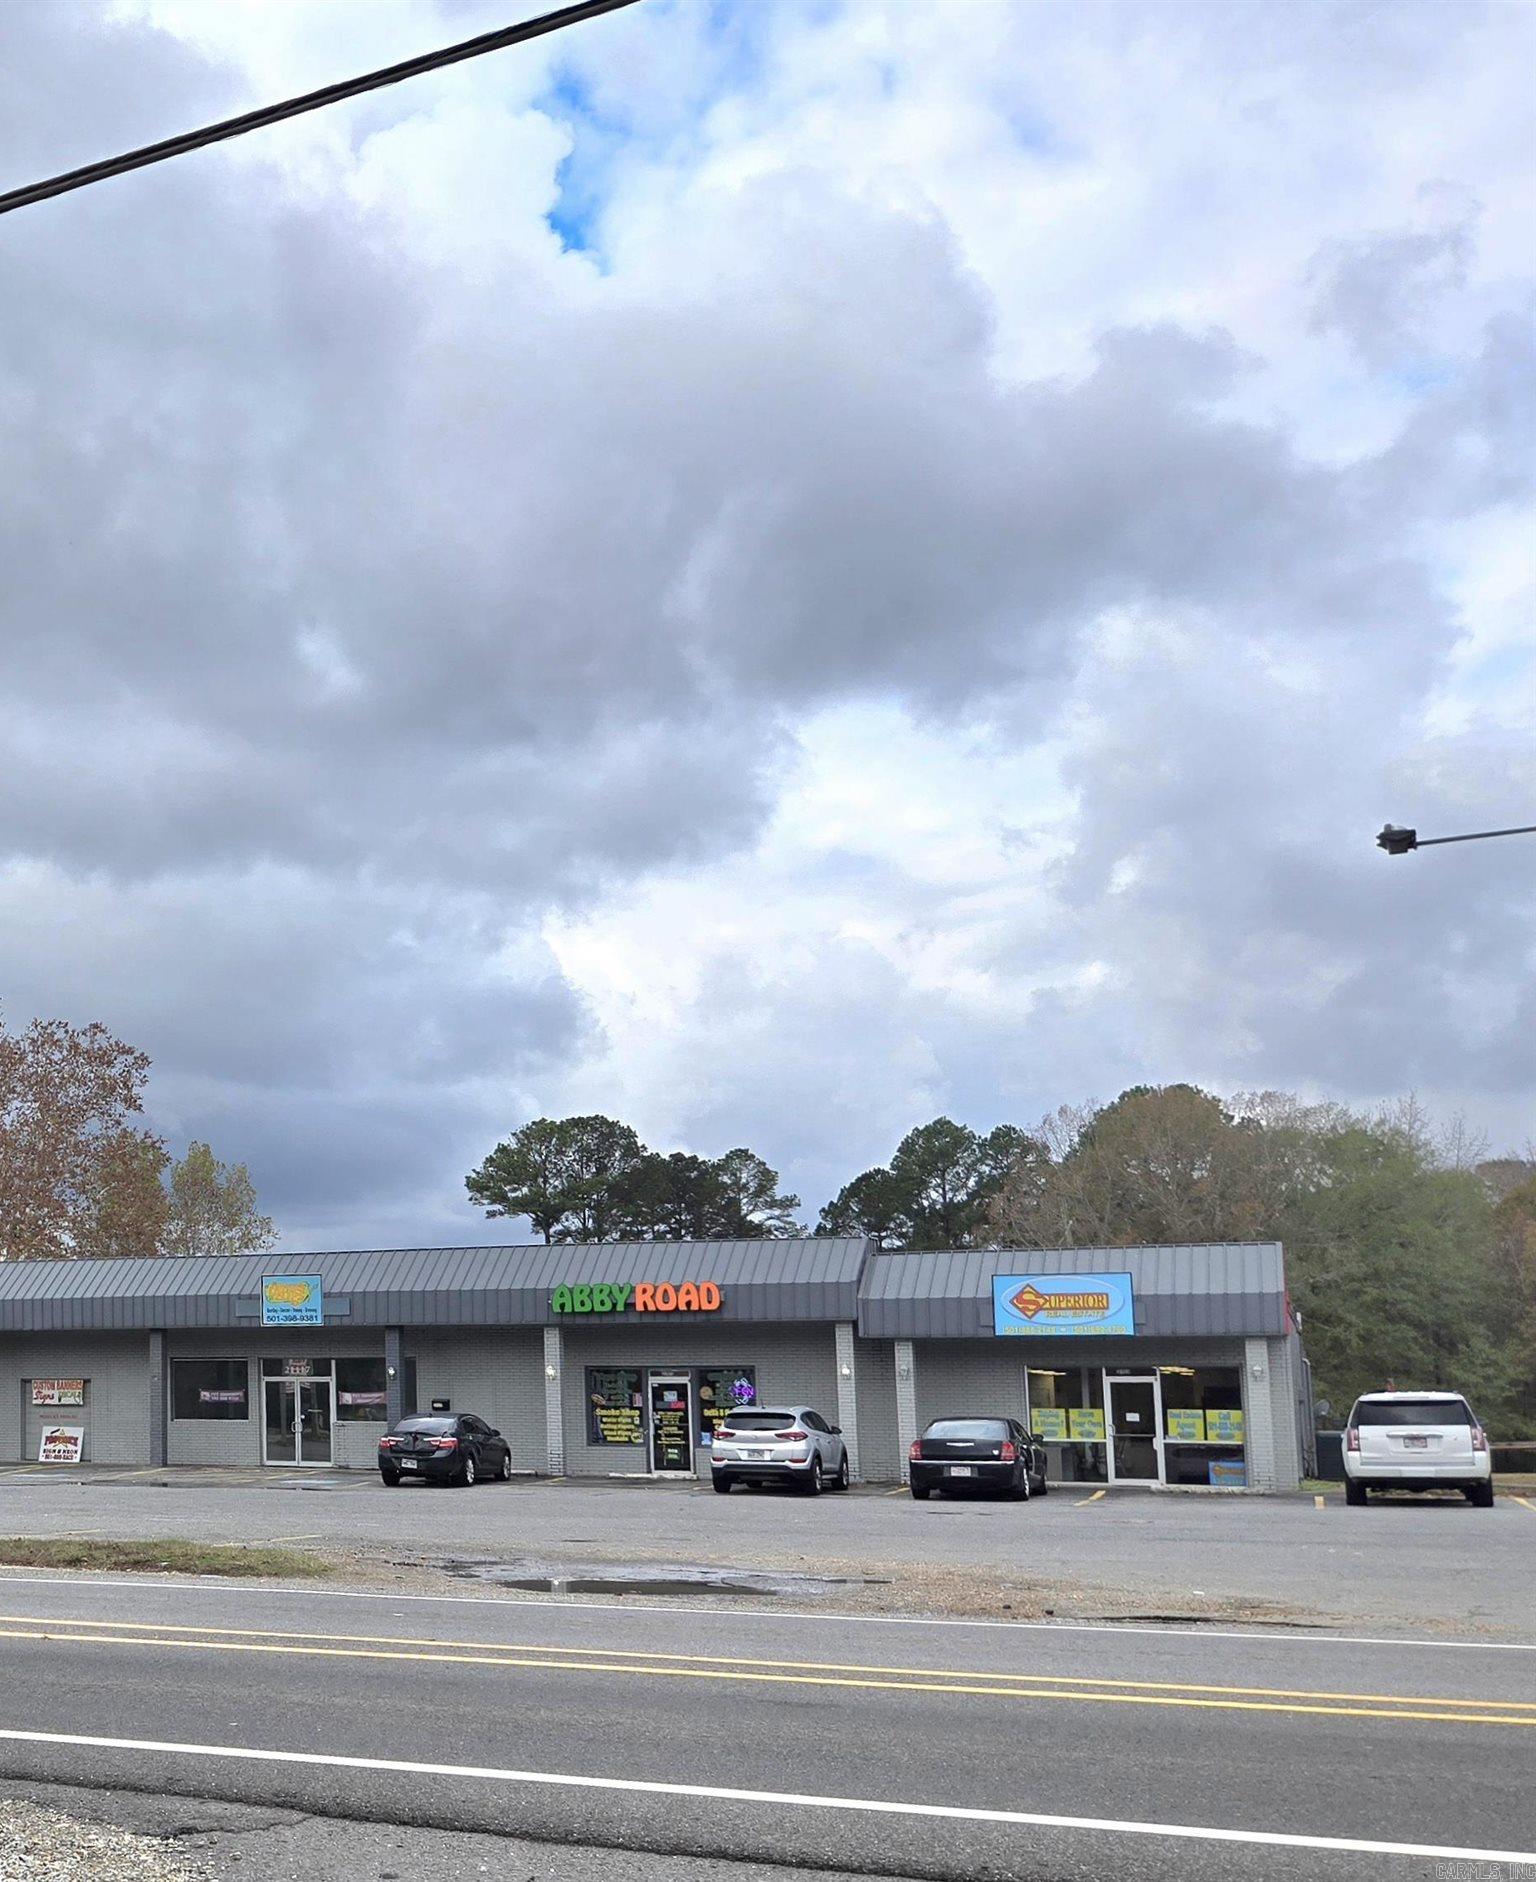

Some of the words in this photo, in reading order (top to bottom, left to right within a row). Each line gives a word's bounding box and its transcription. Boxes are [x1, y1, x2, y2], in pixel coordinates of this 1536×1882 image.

[552, 1282, 633, 1312] ABBY
[635, 1280, 721, 1311] ROAD
[1011, 1287, 1108, 1315] SUPERIOR
[595, 1408, 620, 1416] Smoke
